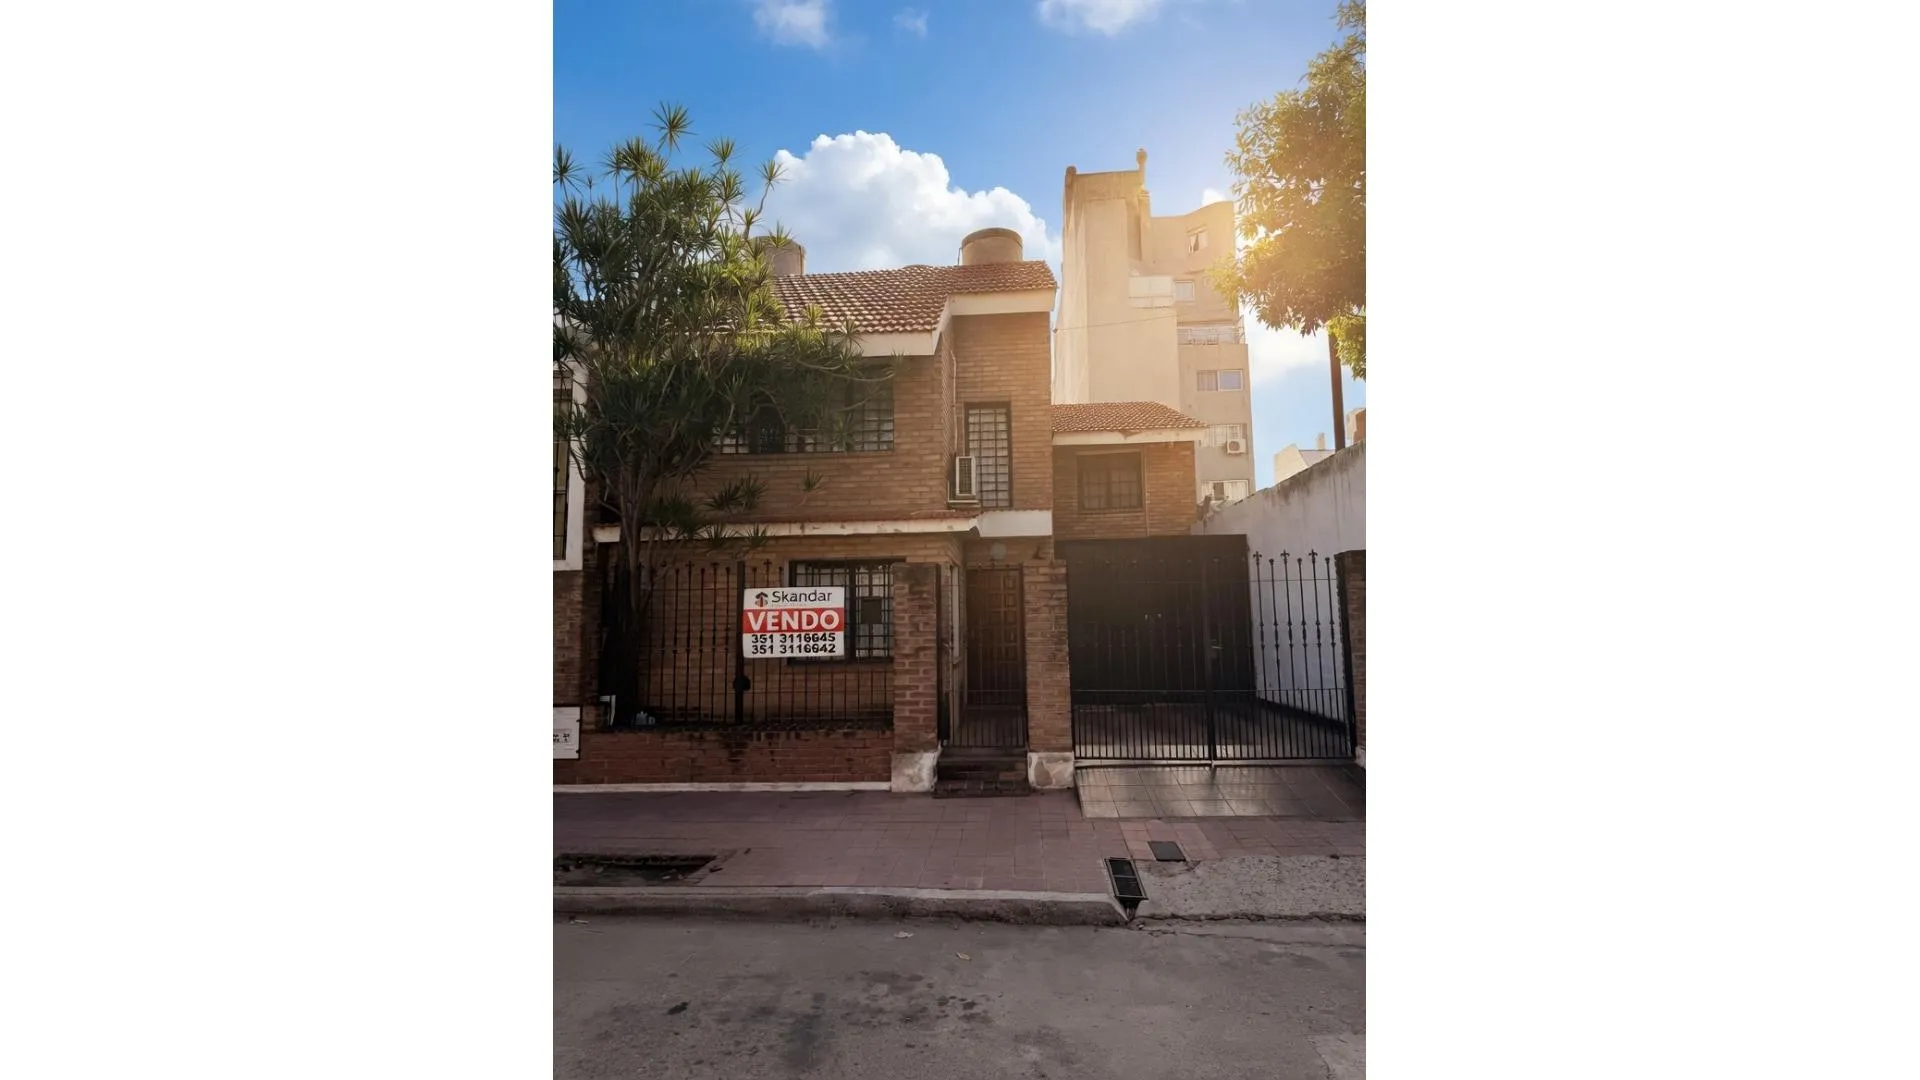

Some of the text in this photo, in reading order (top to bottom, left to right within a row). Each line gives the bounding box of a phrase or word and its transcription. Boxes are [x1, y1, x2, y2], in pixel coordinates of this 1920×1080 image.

[771, 590, 832, 603] Skandar
[747, 609, 840, 631] VENDO
[751, 633, 774, 643] 351
[751, 644, 774, 654] 351
